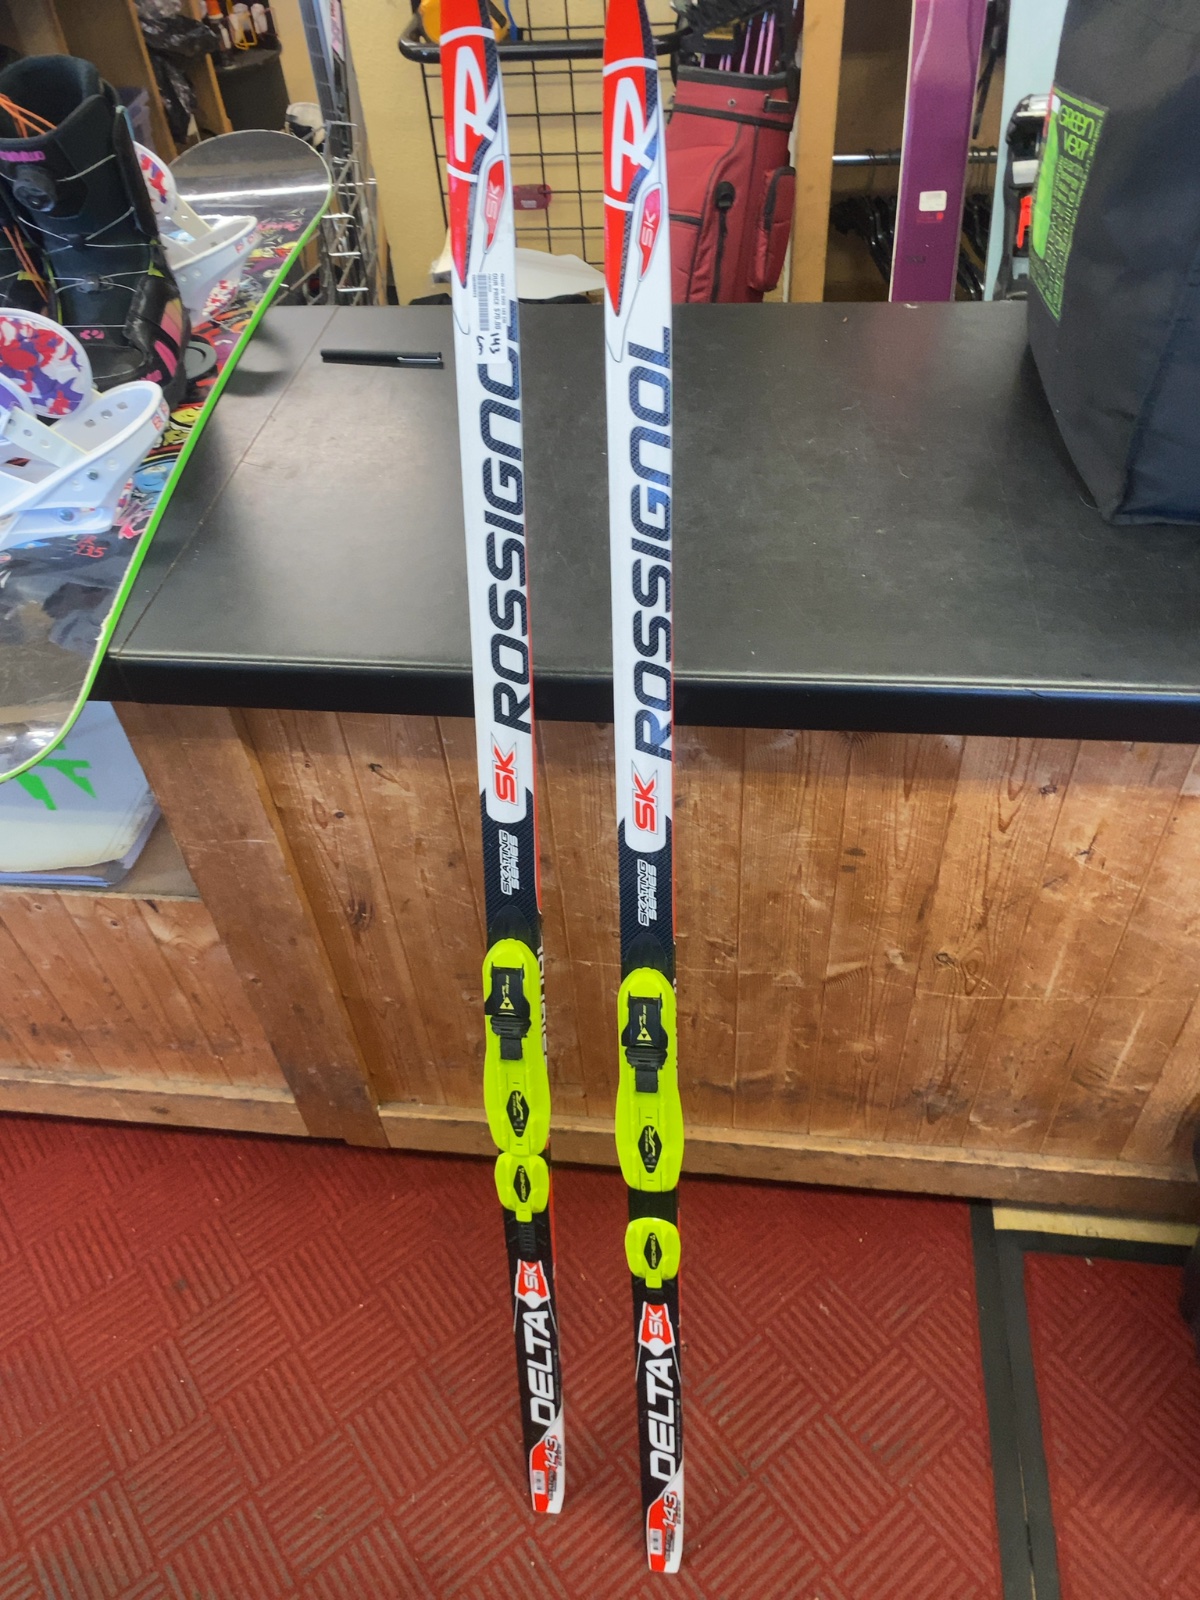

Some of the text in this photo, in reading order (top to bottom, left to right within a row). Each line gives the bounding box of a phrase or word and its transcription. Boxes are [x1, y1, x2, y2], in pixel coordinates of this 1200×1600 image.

[641, 210, 656, 248] SK
[489, 332, 501, 354] 143
[629, 327, 672, 760] ROSSIGNOL
[494, 744, 515, 803] SK
[634, 773, 656, 832] SK
[499, 829, 513, 896] SKATING
[508, 833, 520, 891] SERIES
[637, 858, 650, 926] SKATING
[646, 863, 658, 921] SERIES
[524, 1264, 539, 1290] SK
[649, 1309, 664, 1337] SK
[523, 1311, 555, 1427] DELTA
[645, 1358, 676, 1482] DELTA
[545, 1435, 558, 1469] 143
[664, 1492, 678, 1528] 143
